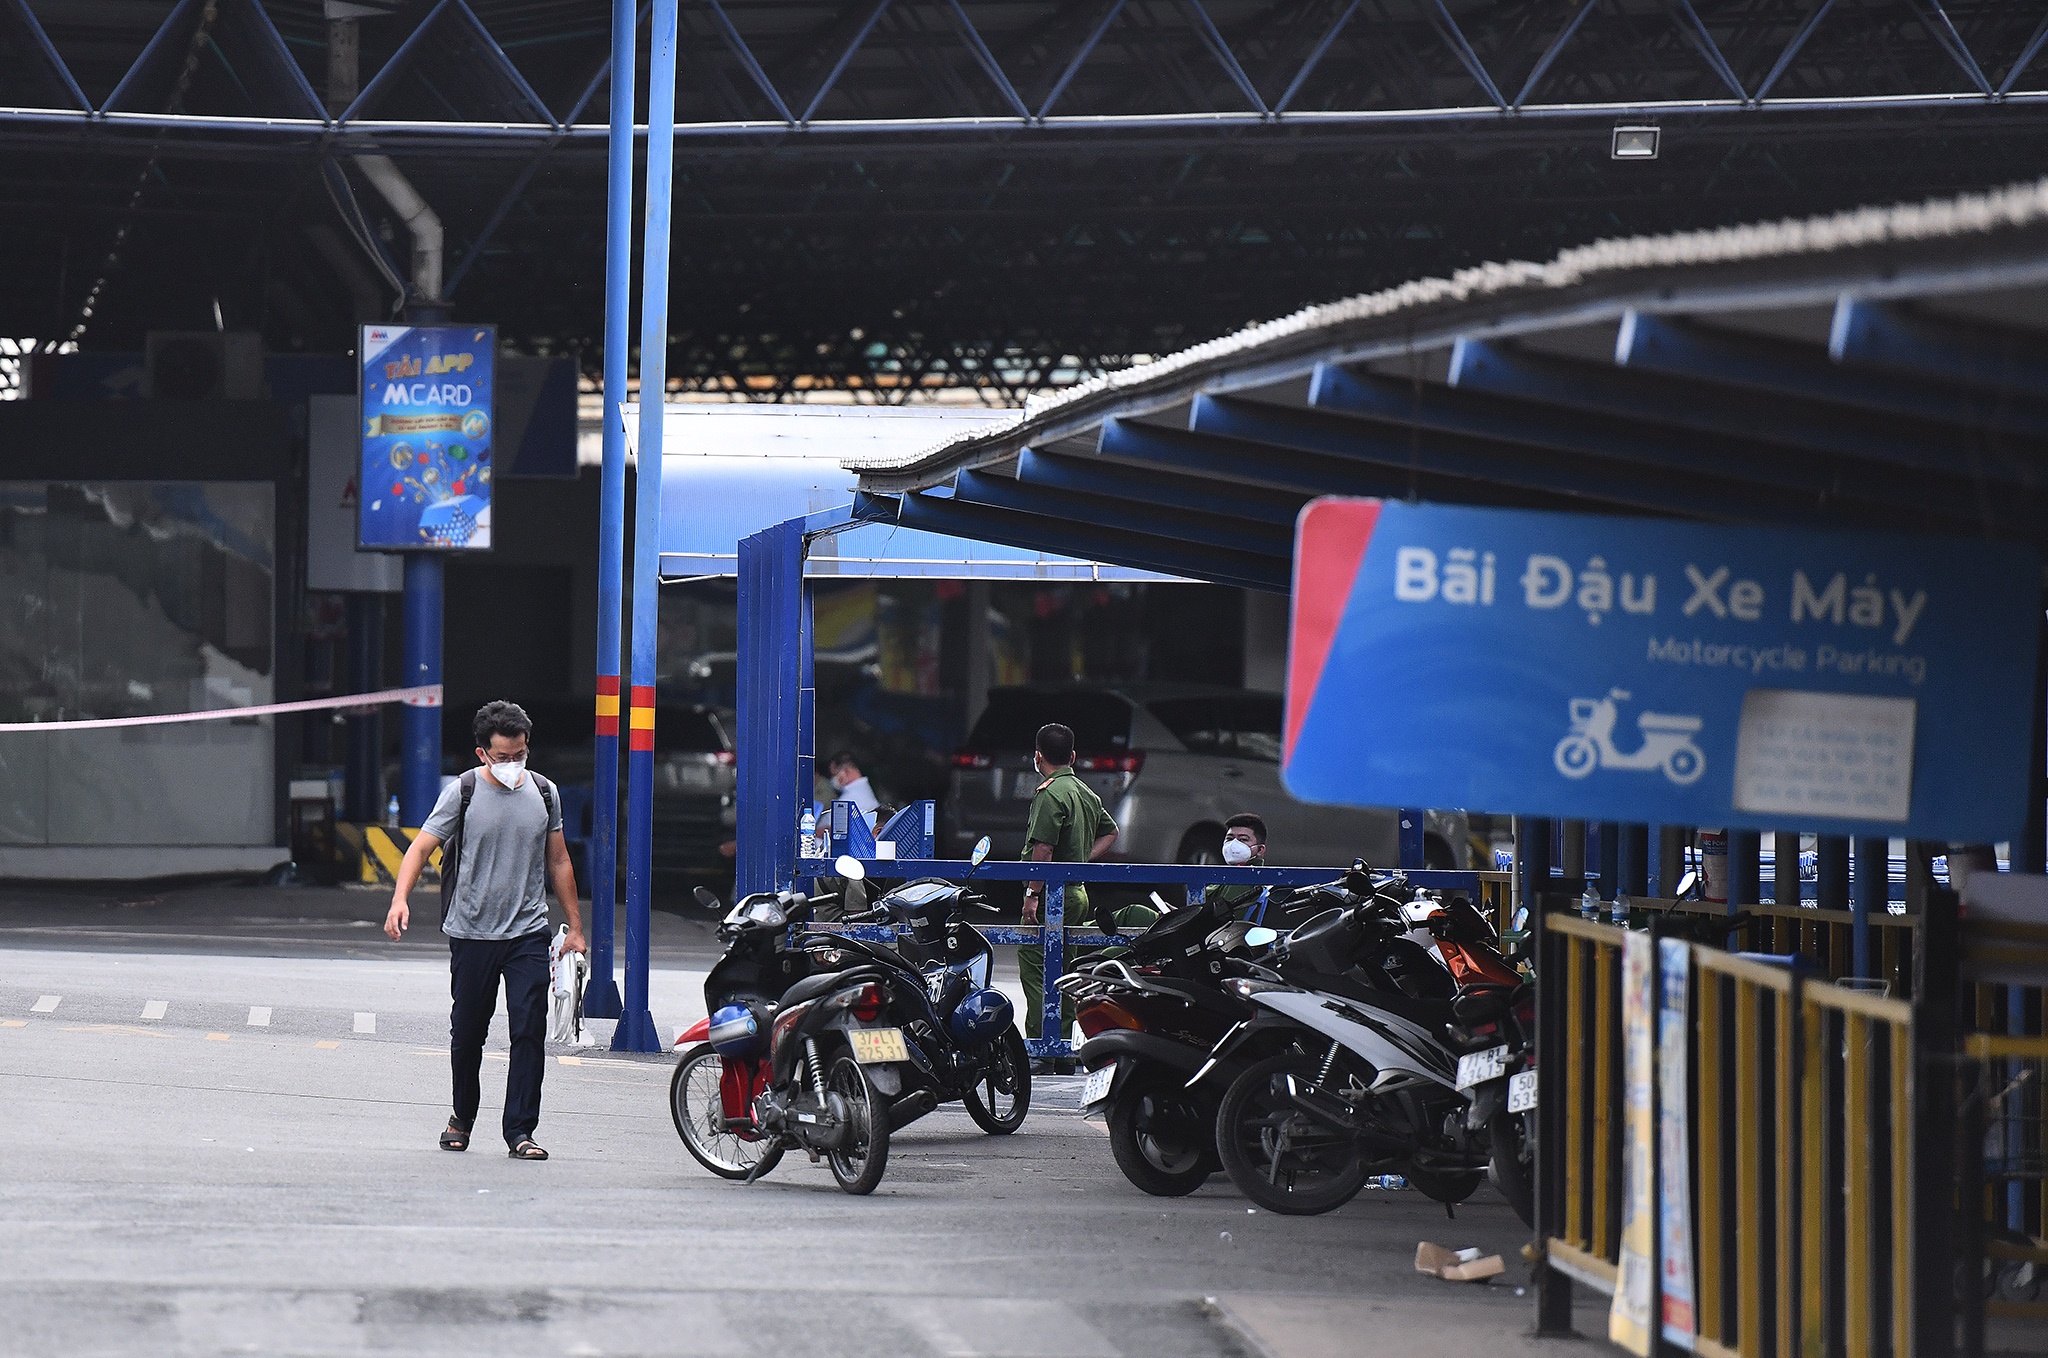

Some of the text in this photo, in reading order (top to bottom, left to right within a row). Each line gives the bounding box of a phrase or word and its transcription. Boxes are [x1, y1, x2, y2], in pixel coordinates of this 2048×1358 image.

[424, 353, 473, 375] APP
[1395, 546, 1928, 645] Bãi Đậu Xe Máy
[1648, 636, 1928, 686] Motorcycle Parking
